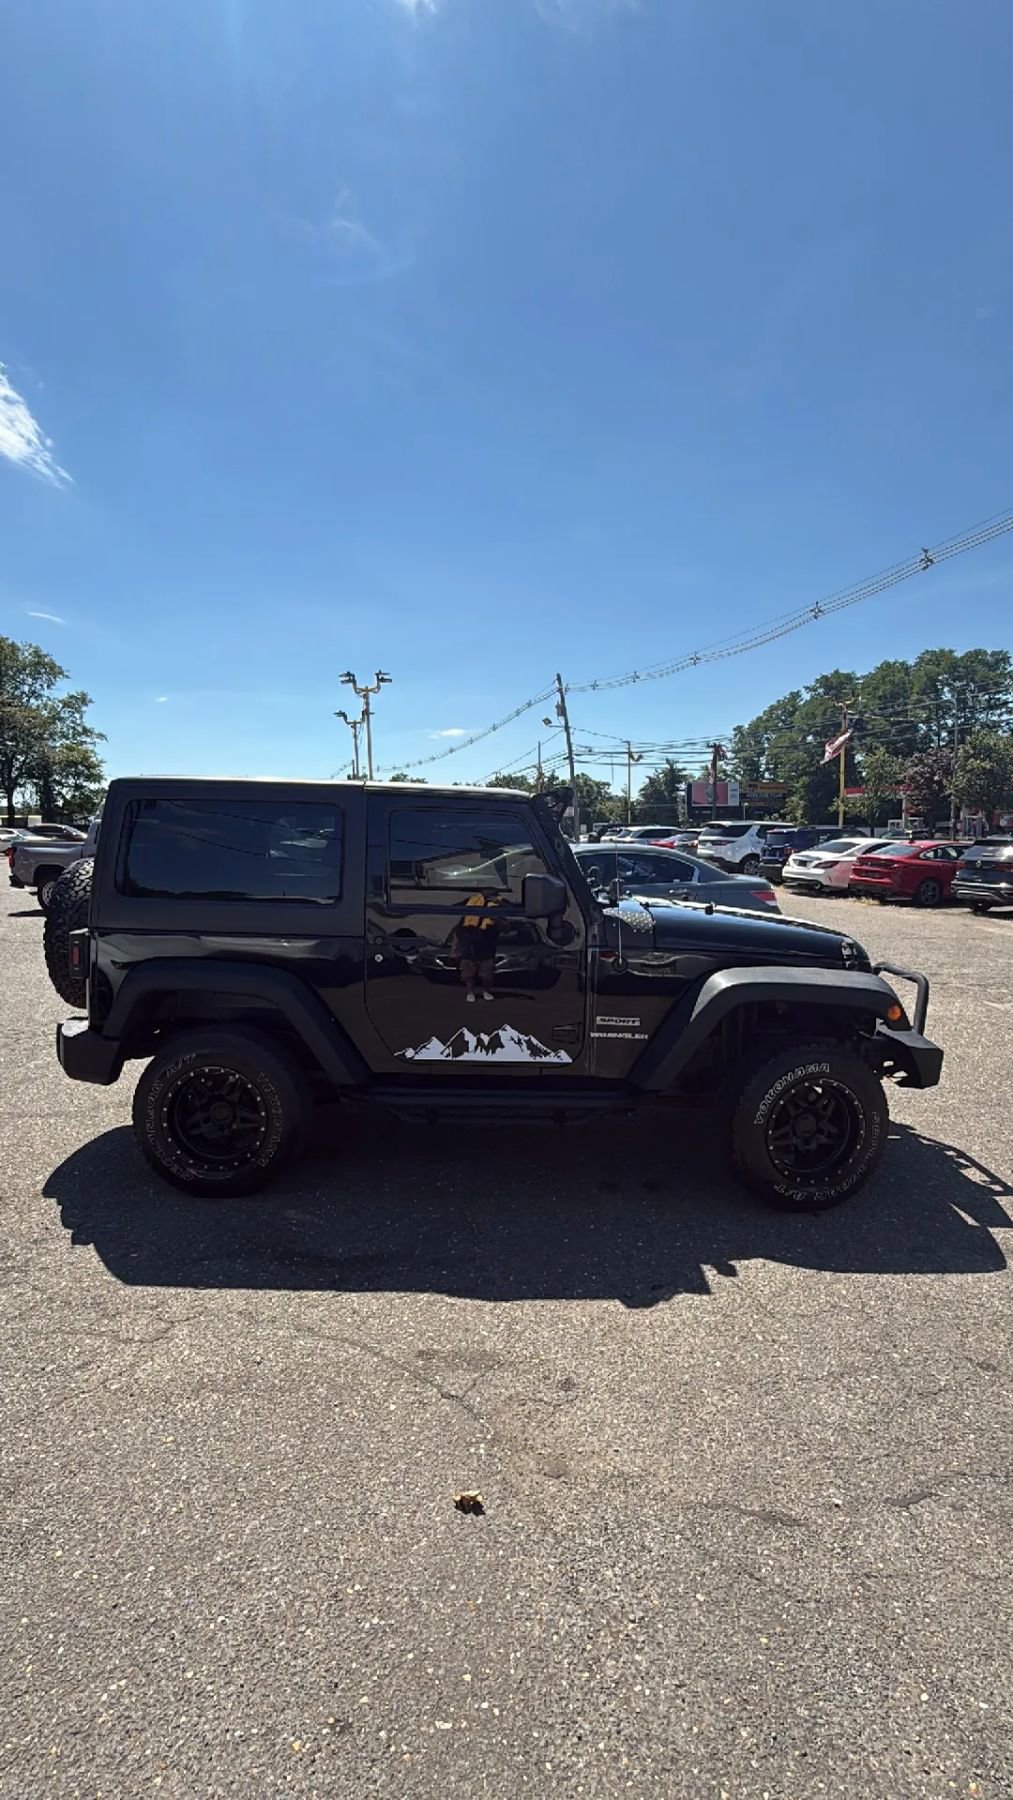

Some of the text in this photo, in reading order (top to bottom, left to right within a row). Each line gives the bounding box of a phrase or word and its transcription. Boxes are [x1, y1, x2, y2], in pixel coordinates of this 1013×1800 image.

[598, 1016, 640, 1026] SPORT
[590, 1032, 649, 1040] WRANGLER
[754, 1063, 830, 1125] YOKOHAMA
